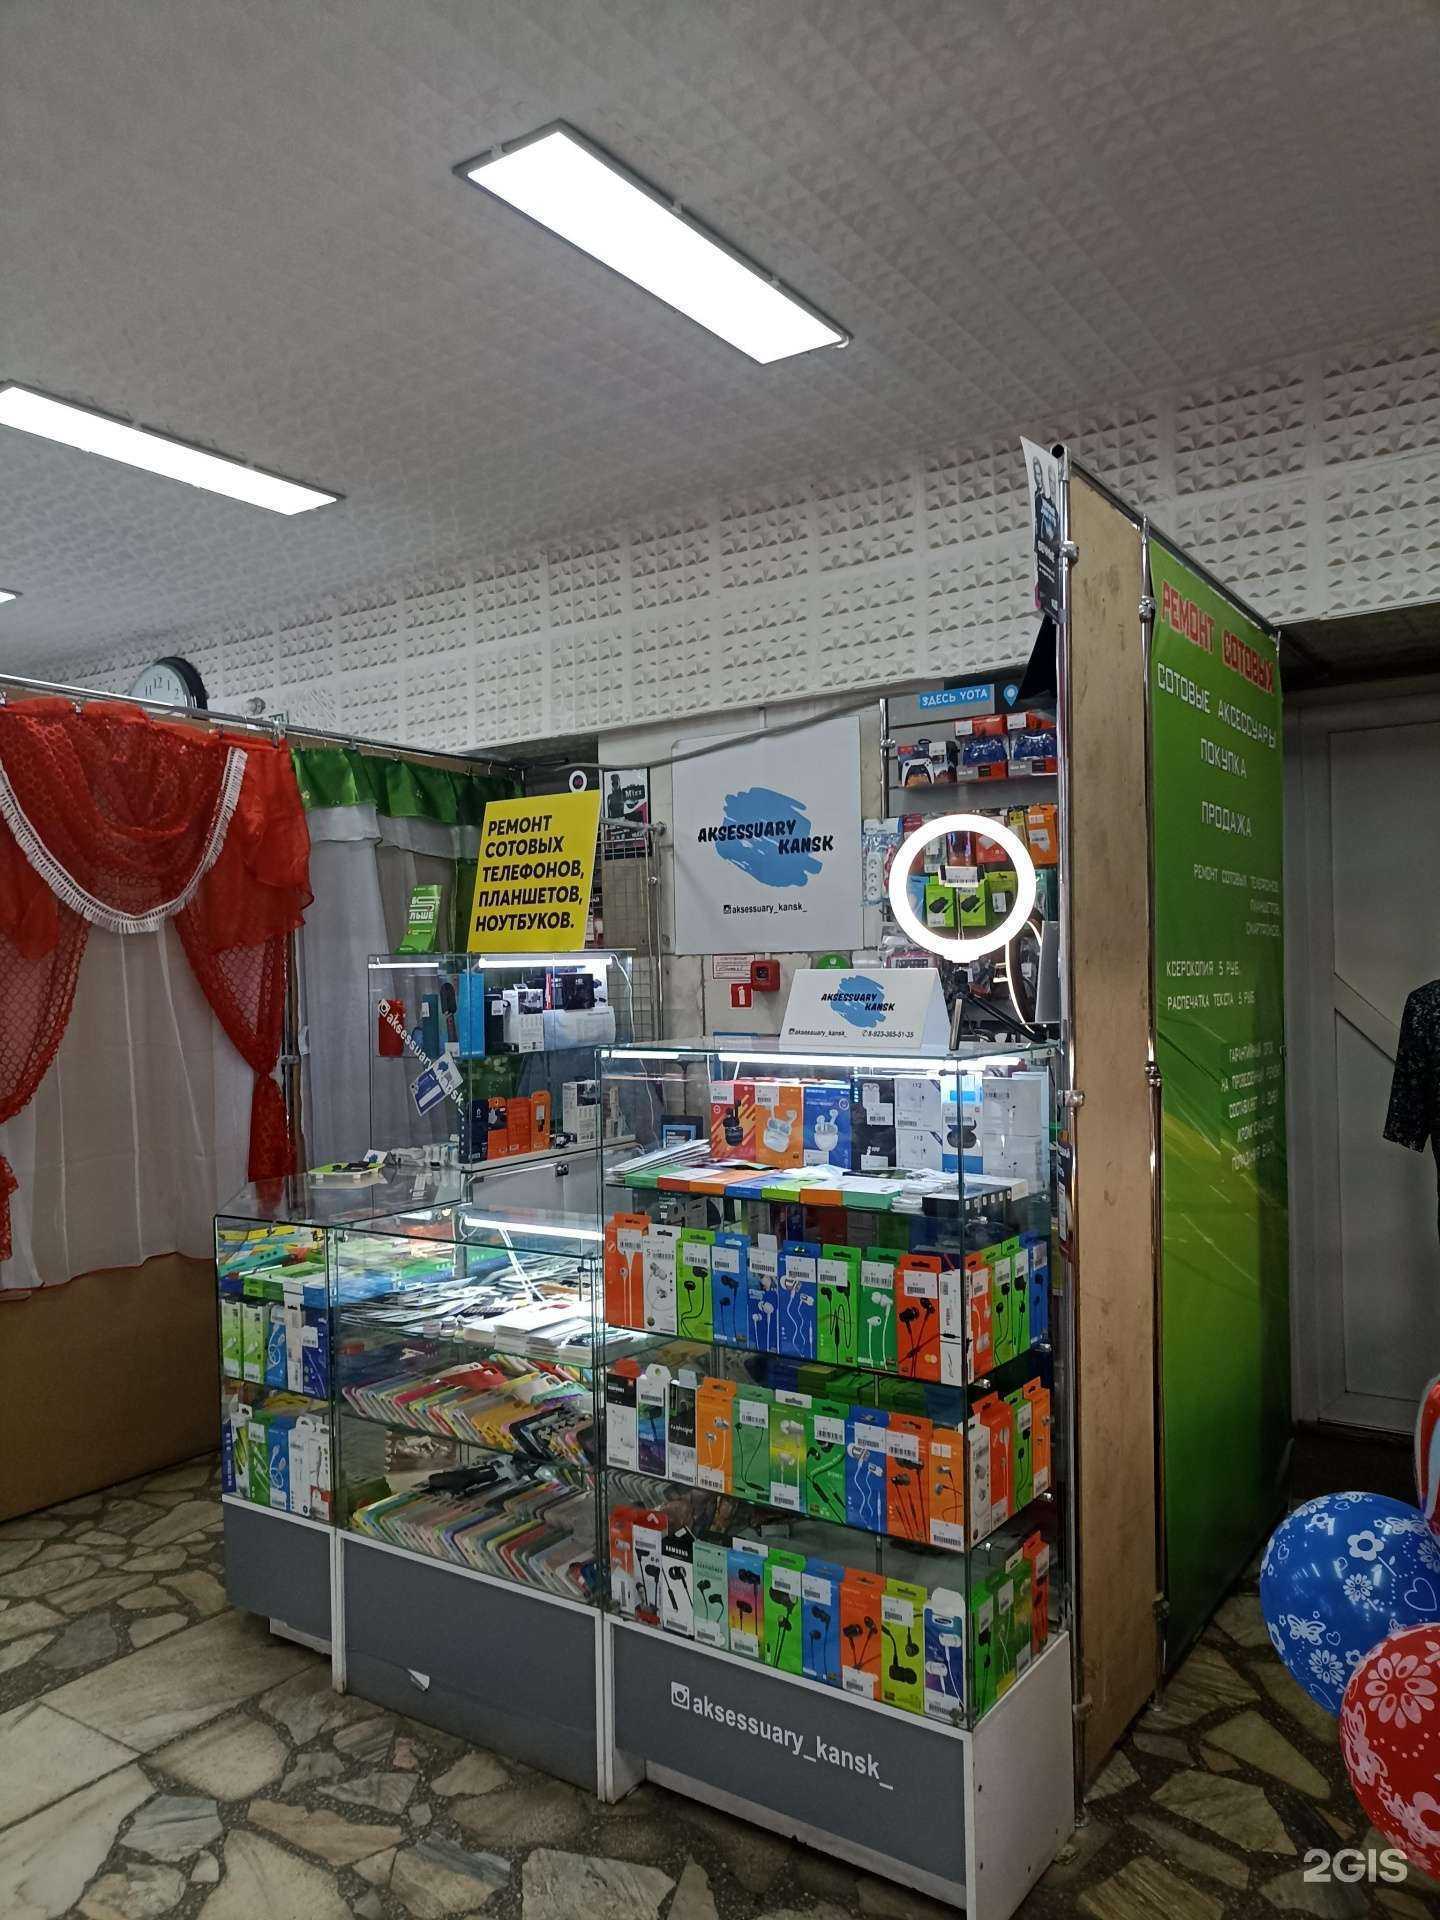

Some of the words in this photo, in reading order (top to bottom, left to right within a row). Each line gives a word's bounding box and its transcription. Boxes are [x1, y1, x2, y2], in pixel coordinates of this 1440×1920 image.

[1161, 579, 1215, 655] РЕМОНТ
[922, 693, 956, 707] ЗДЕСЬ
[960, 687, 988, 701] YOTA
[1157, 662, 1211, 714] СОТОВЫЕ
[1218, 699, 1277, 749] АКСЕССУАРЫ
[1200, 737, 1247, 779] ПОКУПКА
[487, 815, 552, 836] РЕМОНТ
[1201, 800, 1252, 837] ПРОДАЖА
[698, 819, 797, 842] AKSESSUARY
[485, 836, 564, 858] СОТОВЫХ
[778, 835, 834, 855] KANSK
[483, 860, 584, 882] ТЕЛЕФОНОВ,
[479, 886, 583, 907] ПЛАНШЕТОВ,
[732, 902, 808, 914] aksessuary_kansk_
[475, 911, 574, 932] НОУТБУКОВ.
[1166, 960, 1214, 976] КСЕРОКОПИЯ
[821, 993, 877, 1002] AKSESSUARY
[864, 1002, 896, 1012] KANSK
[665, 1543, 689, 1558] SAMSUNG
[693, 1695, 894, 1791] aksessuary_kansk_
